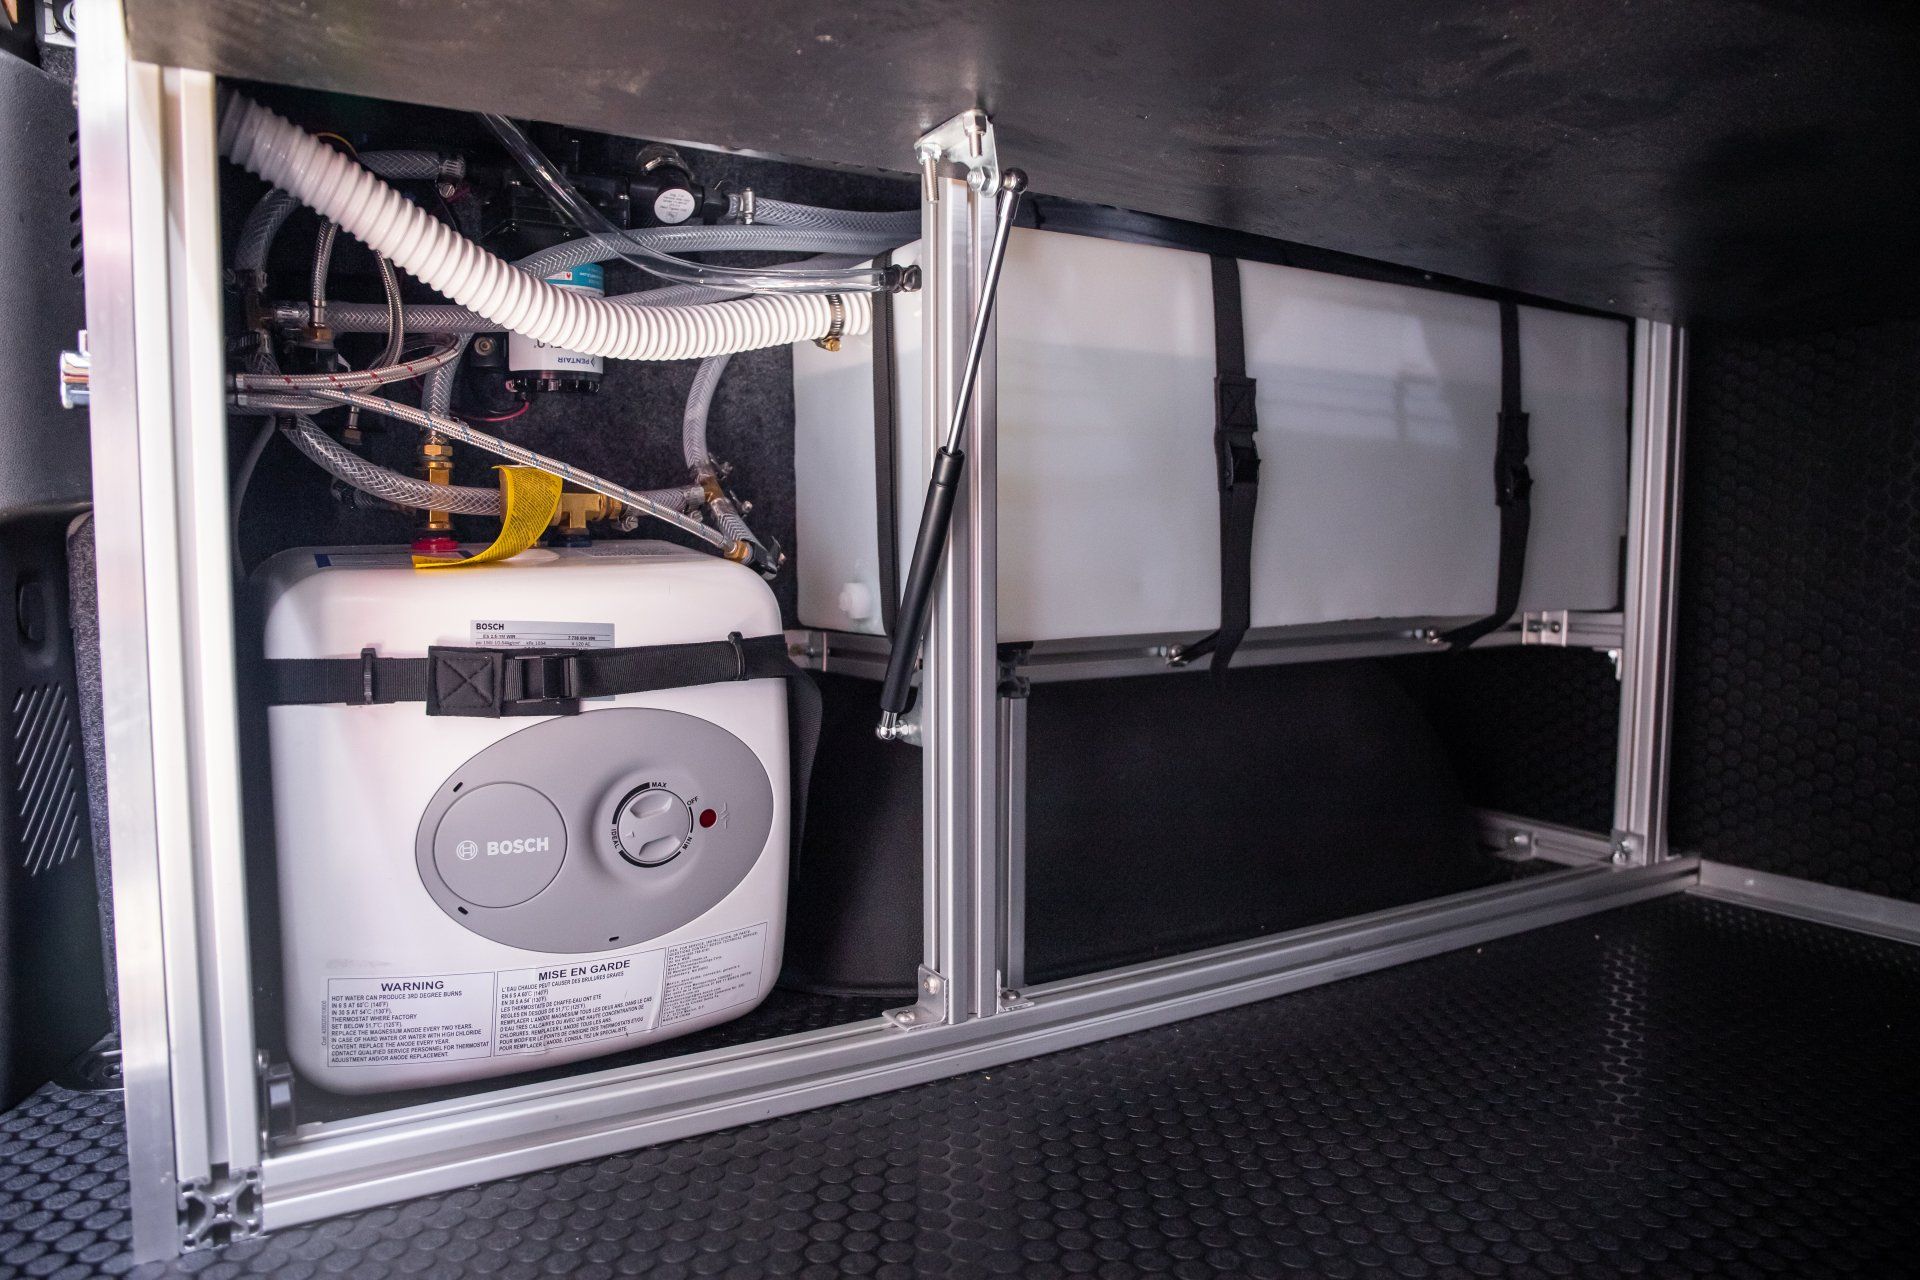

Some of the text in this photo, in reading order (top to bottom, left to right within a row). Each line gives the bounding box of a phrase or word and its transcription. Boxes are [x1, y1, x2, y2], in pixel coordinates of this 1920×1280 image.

[687, 796, 699, 806] OFF
[611, 829, 619, 848] IDEAL
[682, 836, 692, 850] MIN
[486, 837, 548, 856] BOSCH
[538, 960, 630, 981] MISE EN GARDE
[381, 981, 444, 992] WARNING
[456, 1041, 489, 1049] THERMOSTAT
